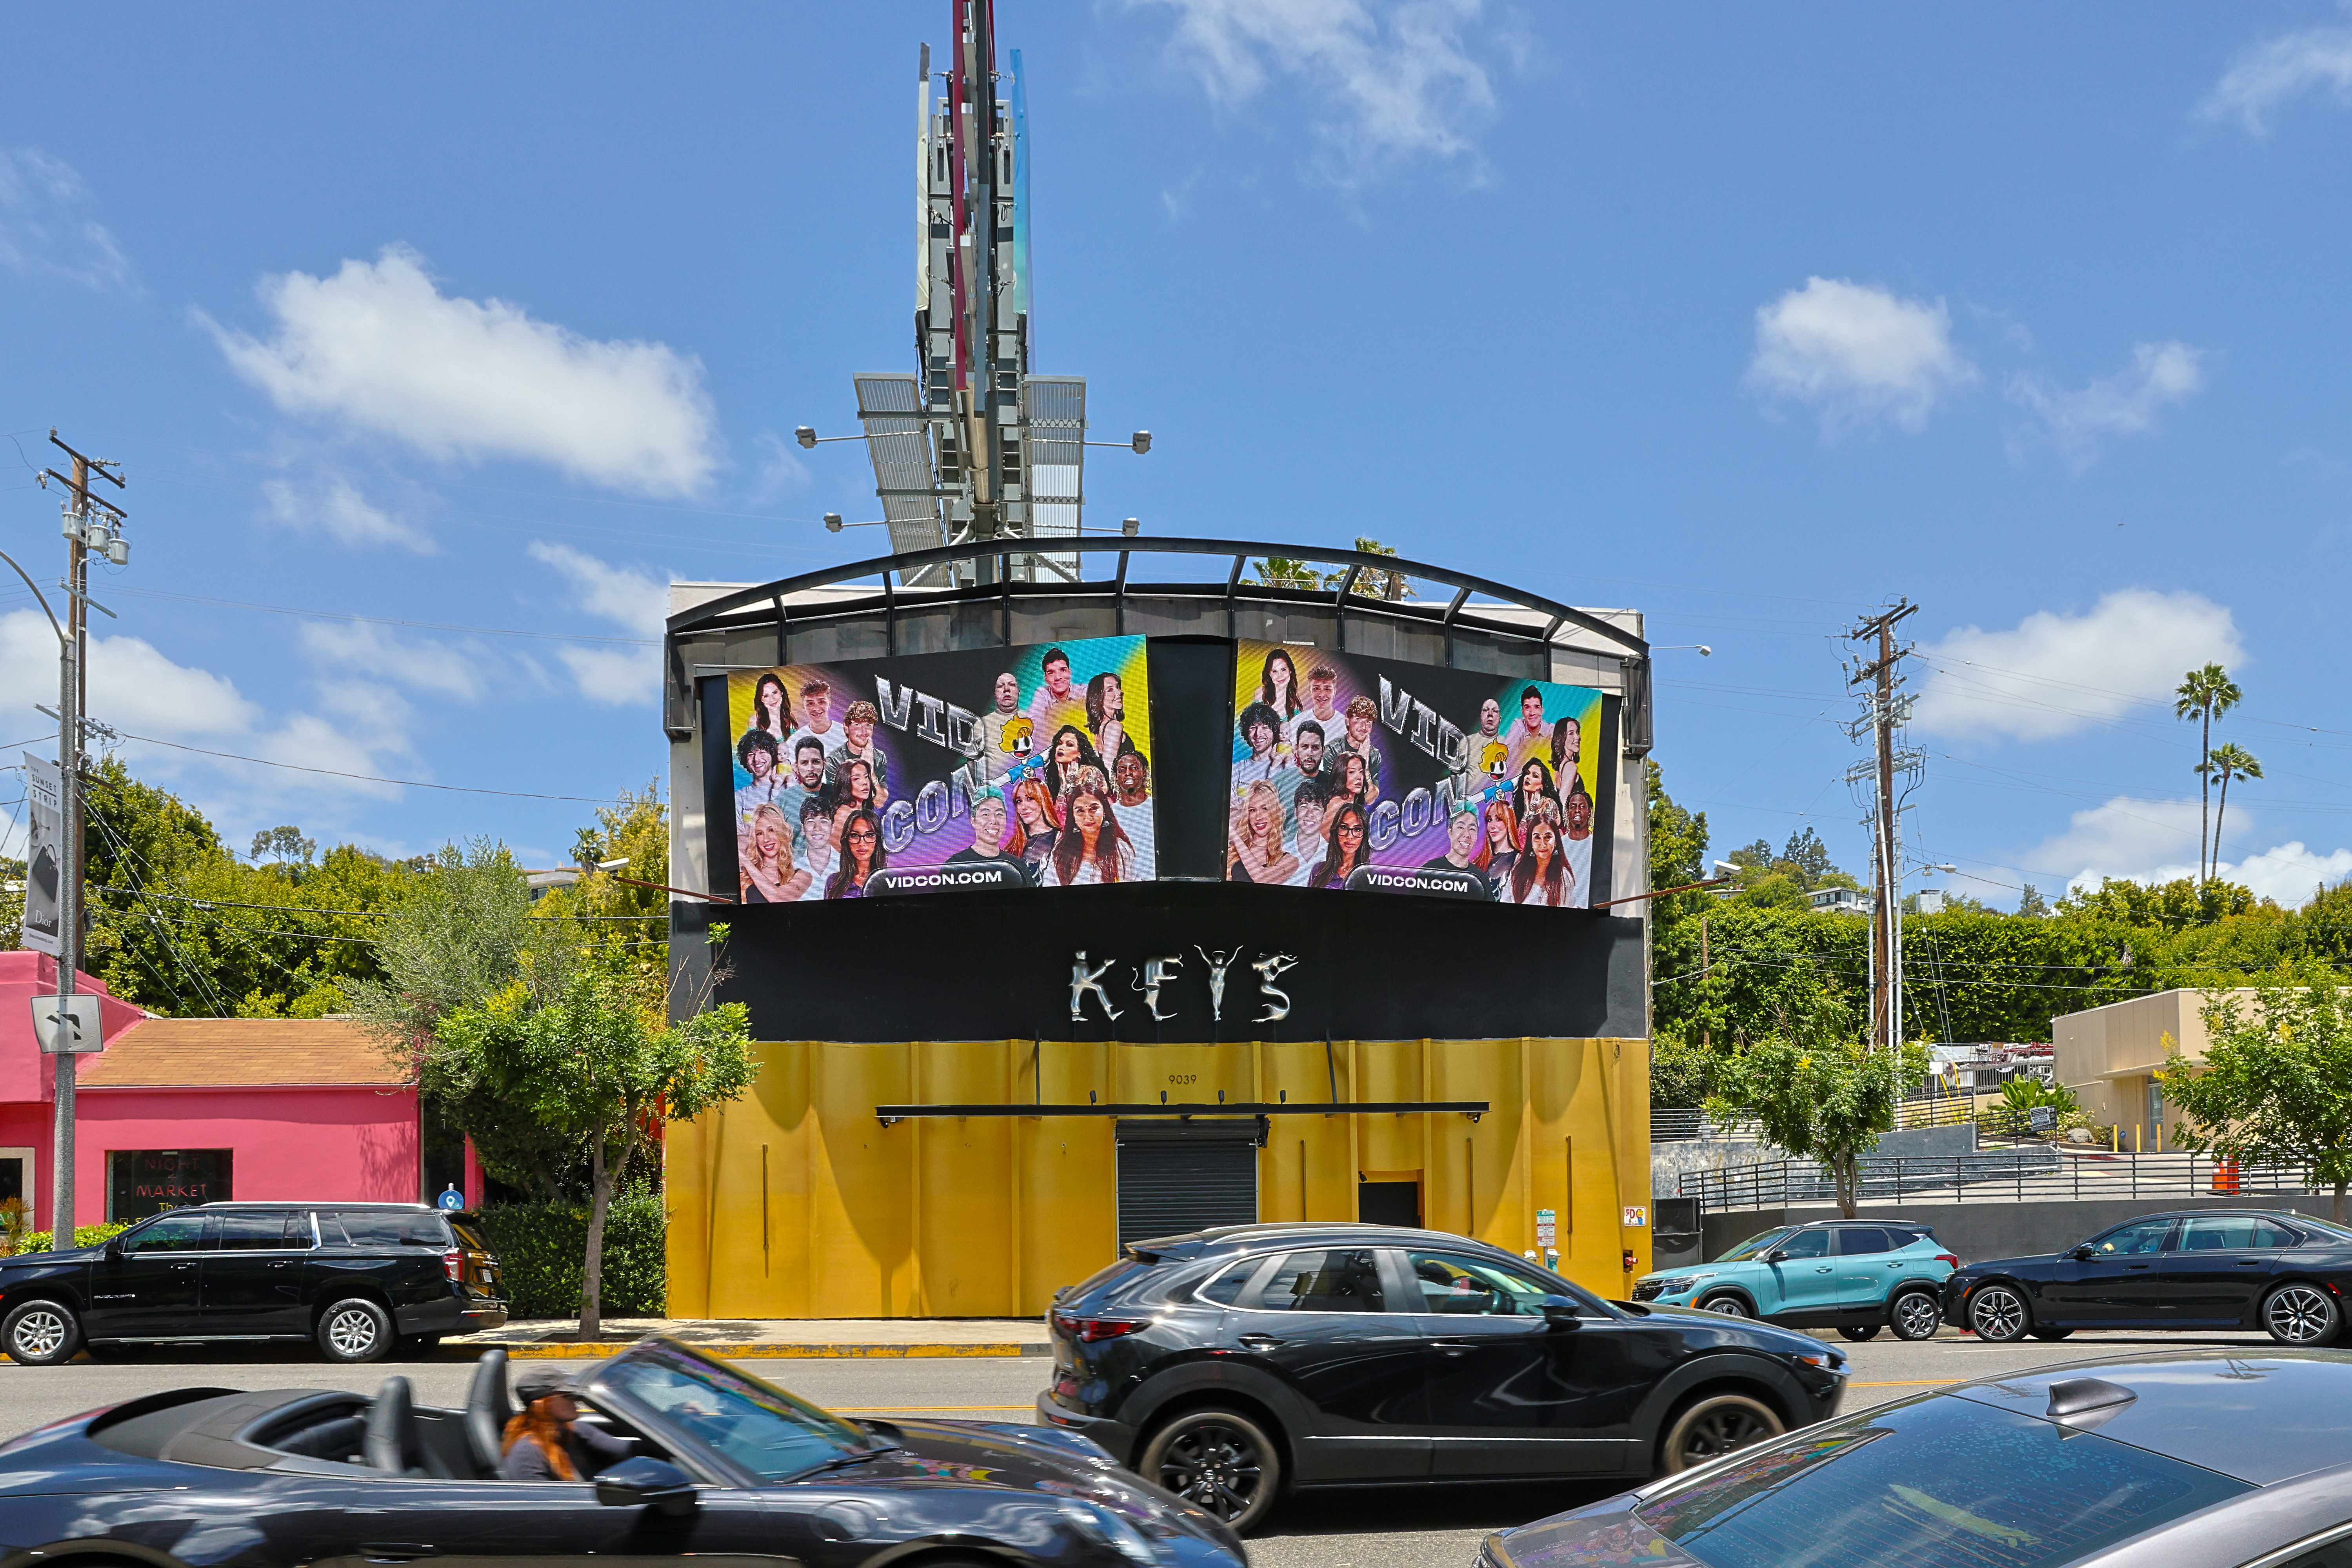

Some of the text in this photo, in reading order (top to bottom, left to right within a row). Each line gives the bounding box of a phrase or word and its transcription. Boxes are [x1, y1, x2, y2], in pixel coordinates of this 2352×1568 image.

[875, 674, 985, 756] VID
[1379, 673, 1469, 773] VID
[32, 774, 57, 792] SUNSET
[33, 789, 57, 807] STRIP
[881, 756, 988, 853] CON
[1368, 770, 1467, 850] CON
[885, 870, 1002, 888] VIDCON.COM
[1367, 873, 1468, 892] VIDCON.COM
[34, 909, 52, 927] Dior
[1068, 944, 1299, 1023] KEYS
[1169, 1074, 1197, 1084] 9039
[145, 1158, 199, 1171] NIGHT
[136, 1184, 207, 1197] MARKET
